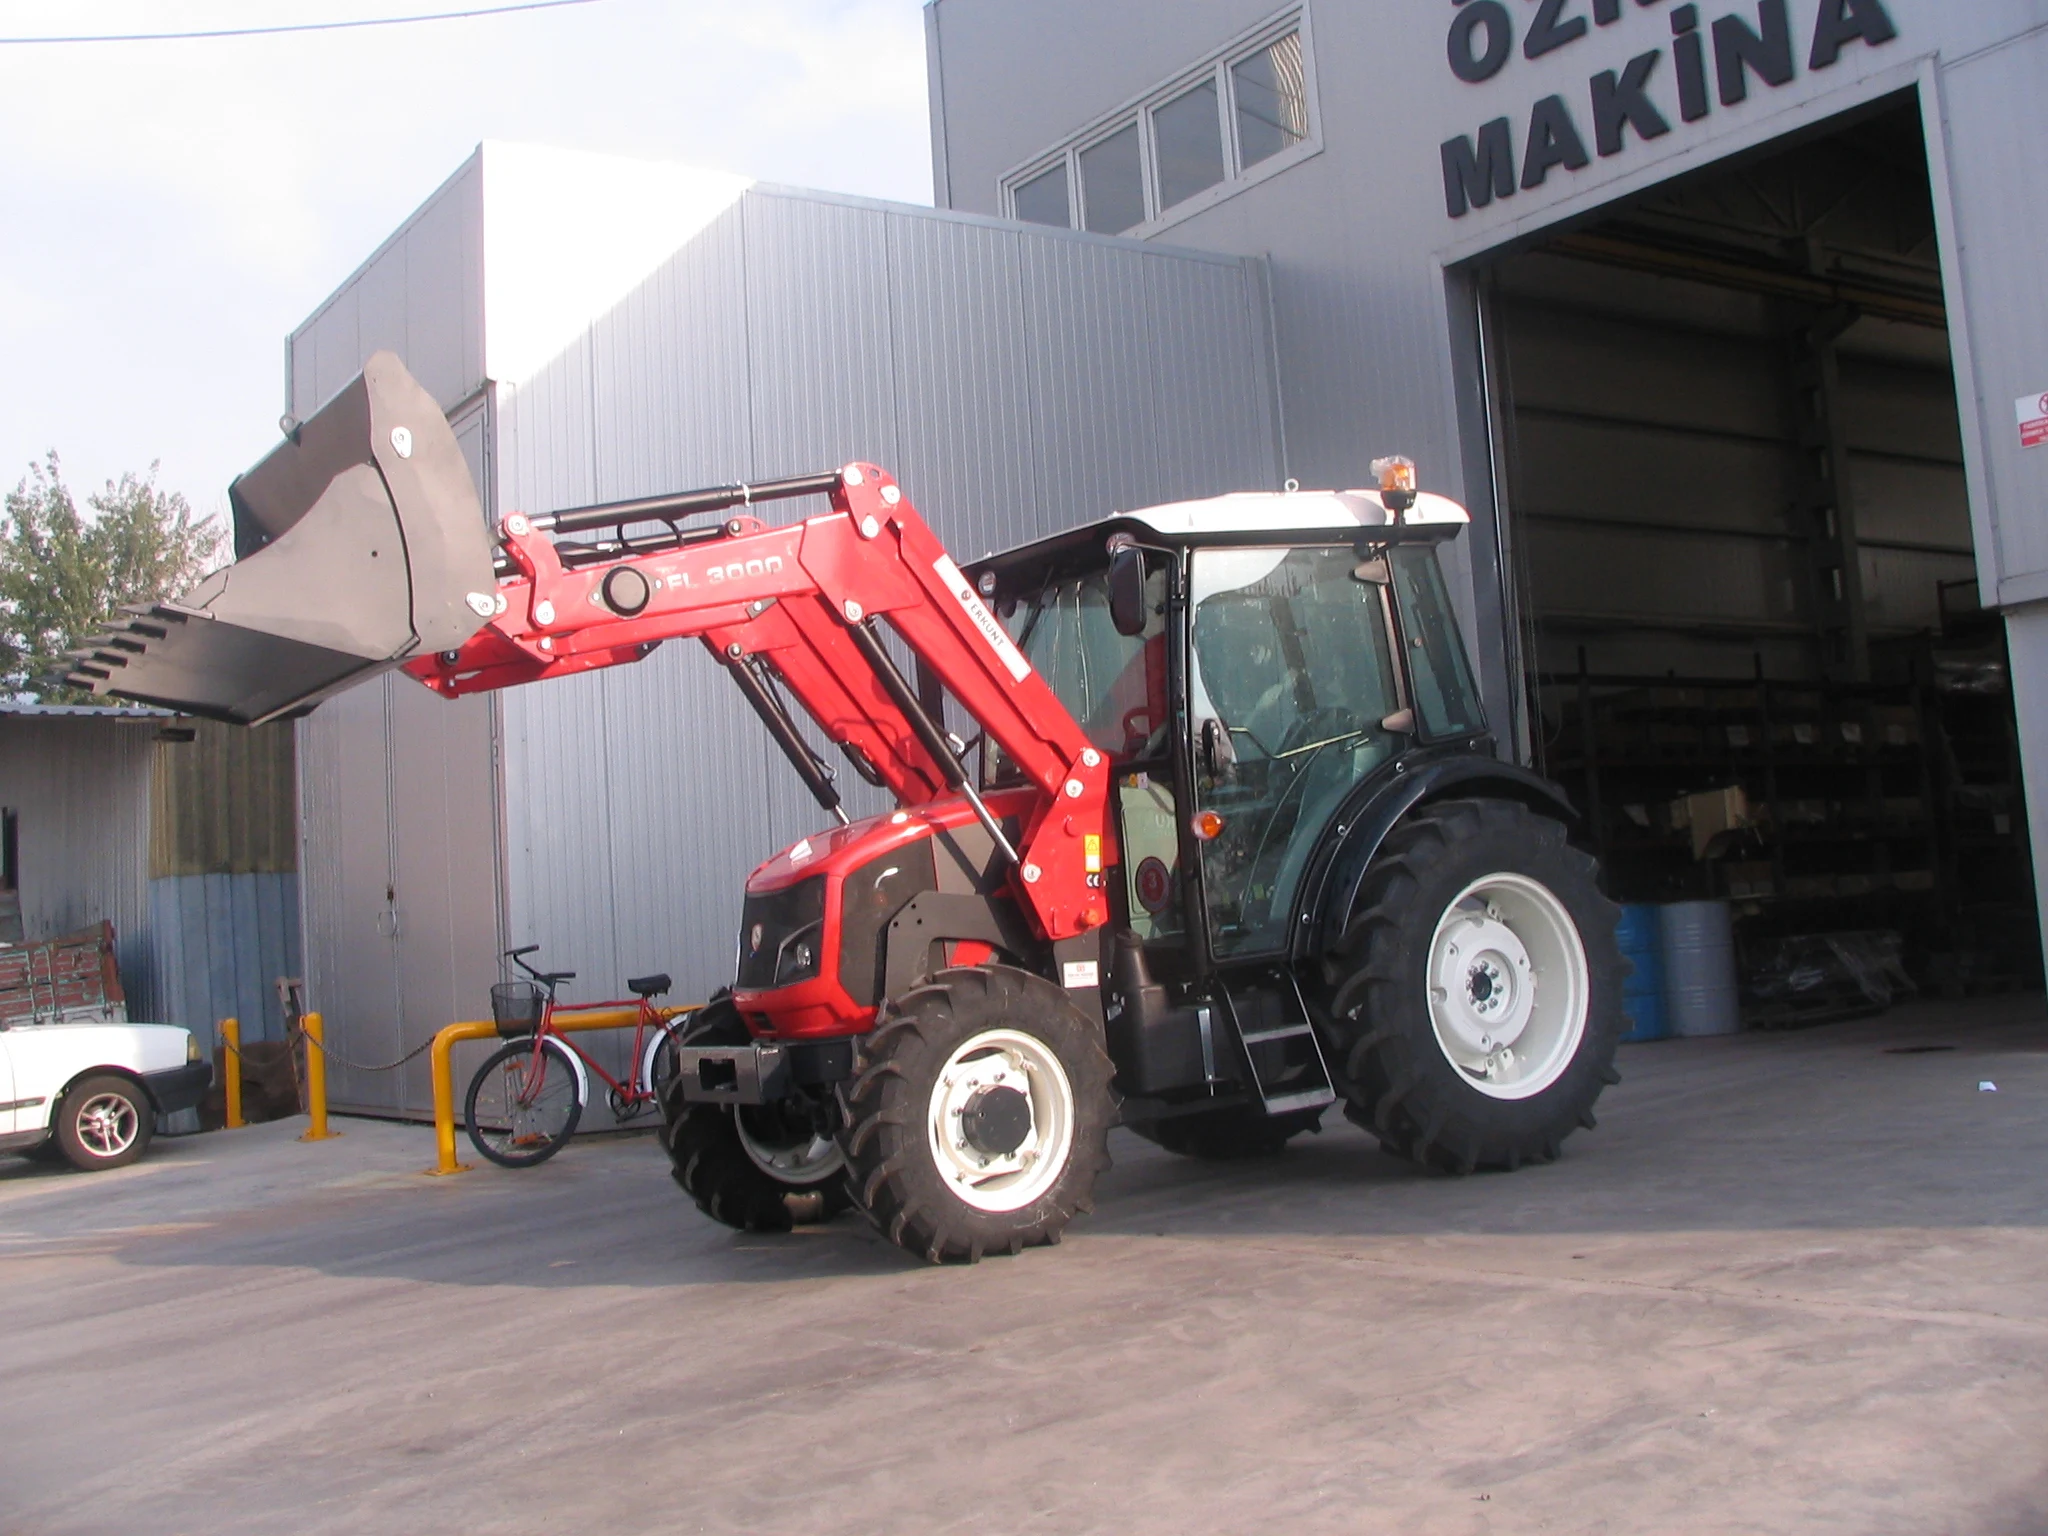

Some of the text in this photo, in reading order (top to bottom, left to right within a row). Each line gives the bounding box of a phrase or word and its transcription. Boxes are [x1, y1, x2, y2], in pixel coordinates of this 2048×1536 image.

[1440, 0, 1897, 219] MAKİNA
[706, 556, 783, 585] 3000
[970, 603, 1005, 647] ERKUNT
